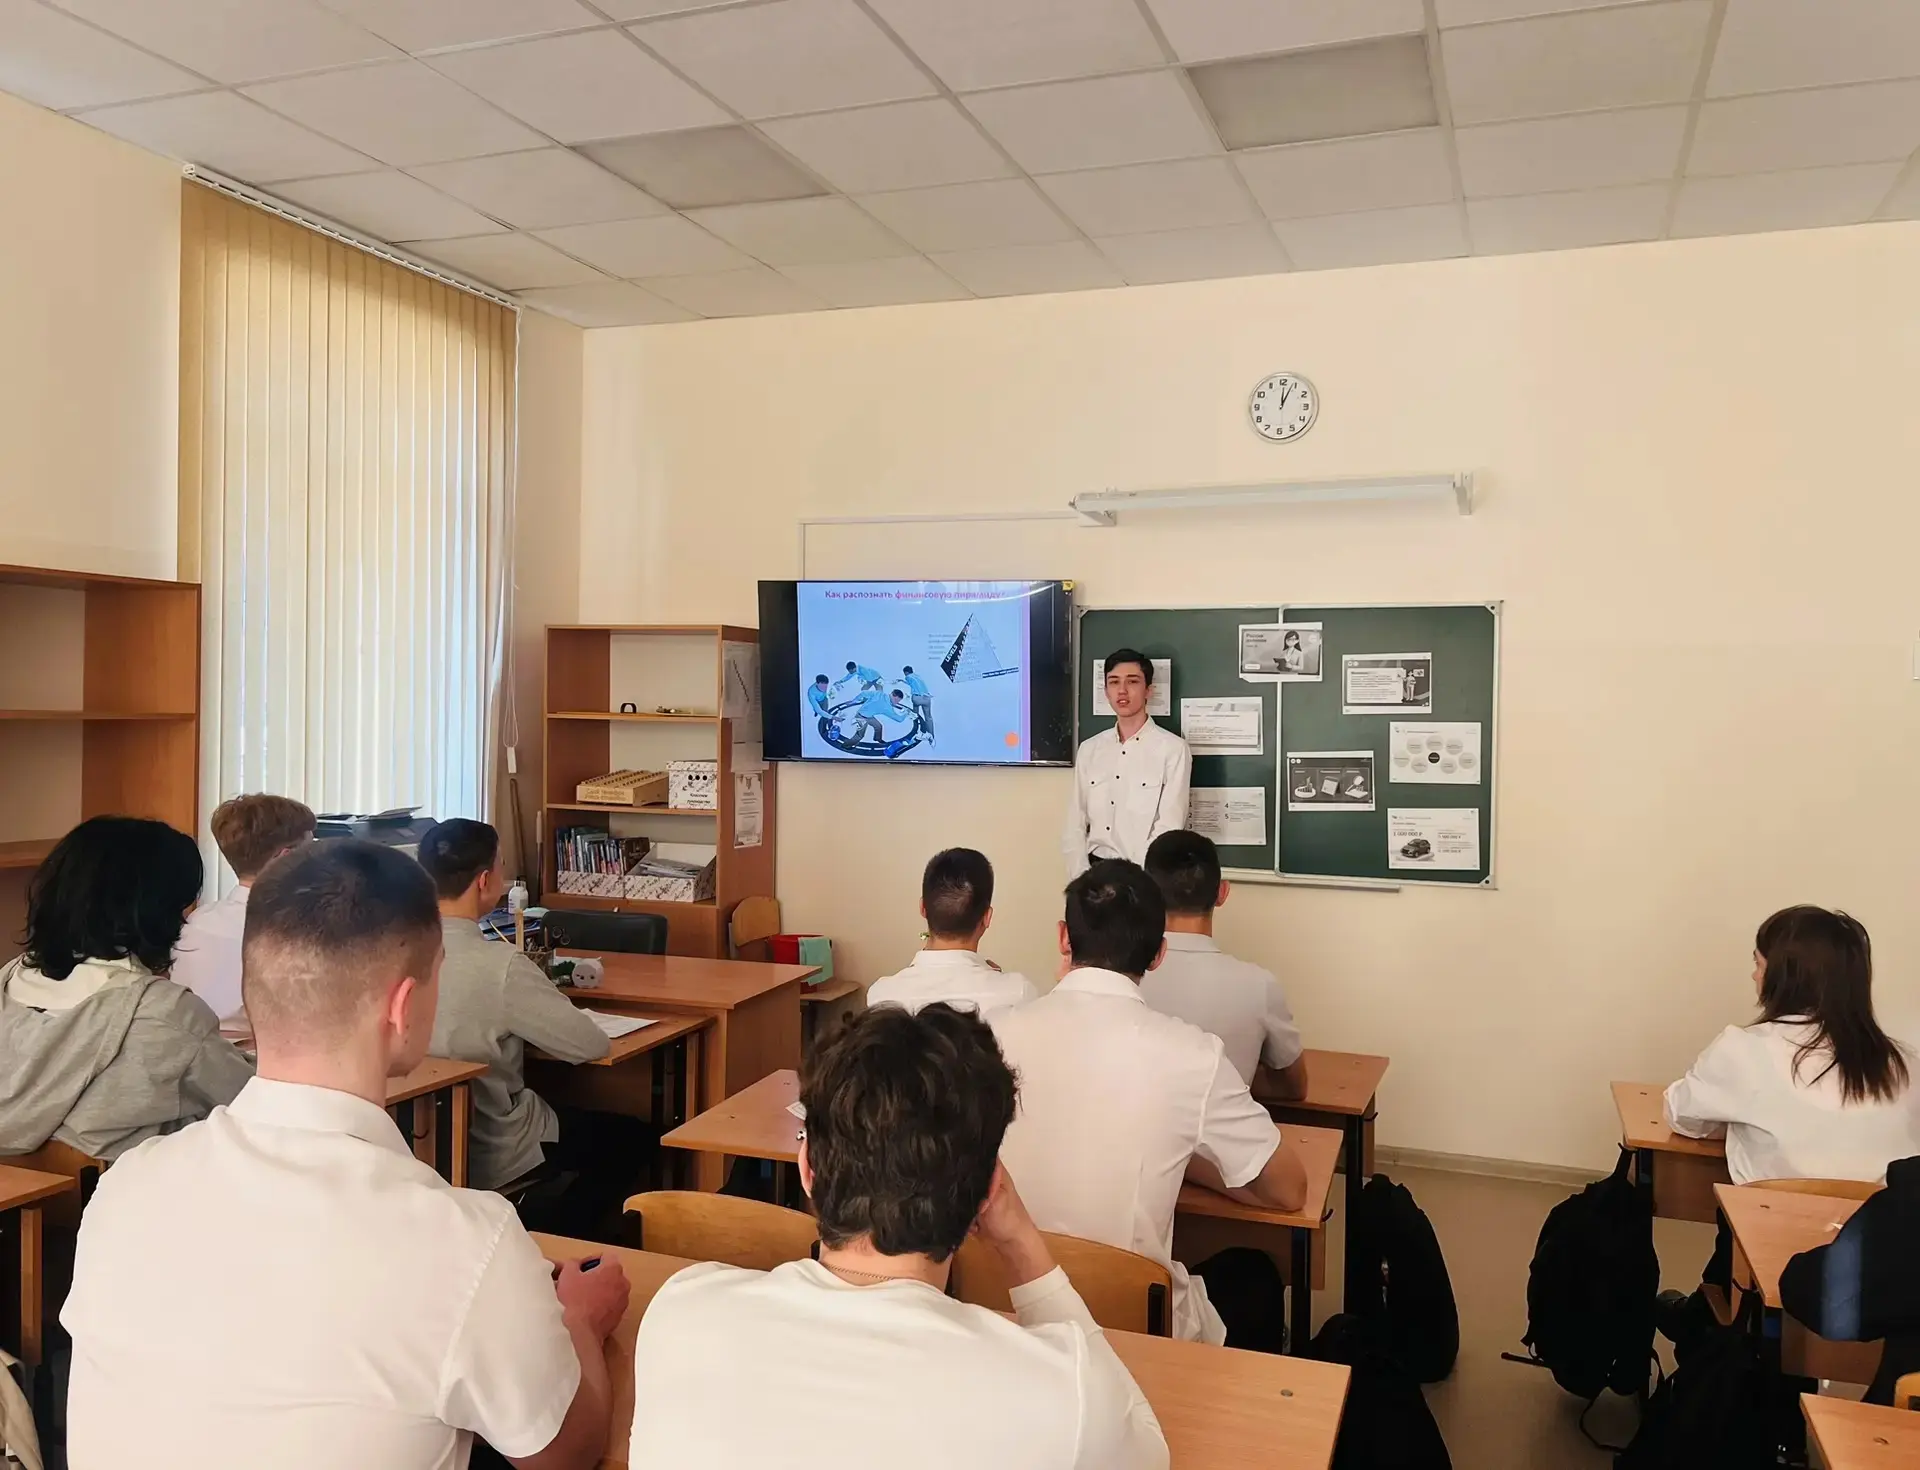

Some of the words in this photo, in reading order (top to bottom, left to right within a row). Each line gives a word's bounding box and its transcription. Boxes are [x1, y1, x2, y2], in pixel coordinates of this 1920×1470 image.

[825, 589, 840, 599] Как
[843, 590, 893, 600] распознать
[895, 589, 952, 600] финансовую
